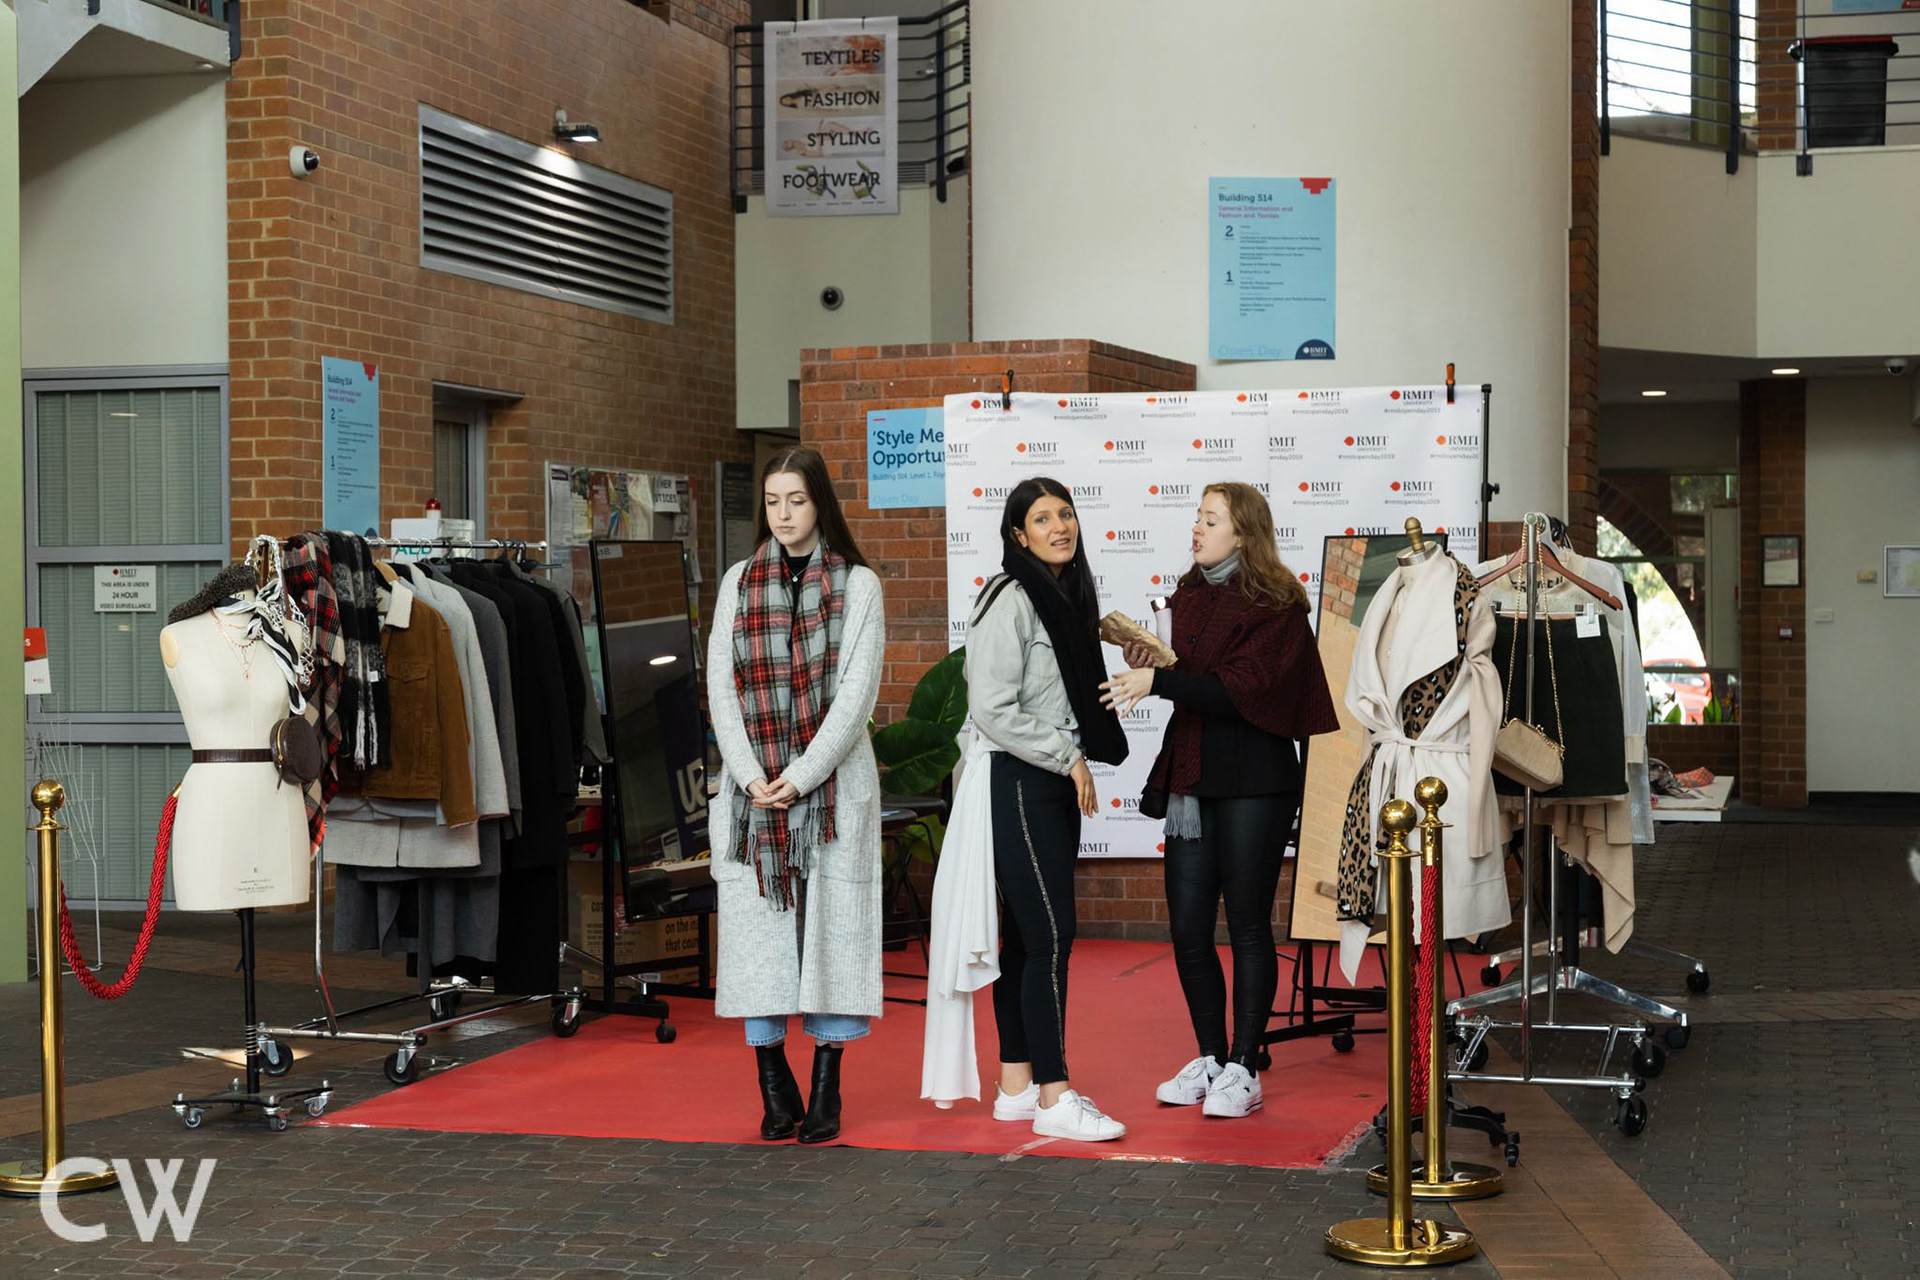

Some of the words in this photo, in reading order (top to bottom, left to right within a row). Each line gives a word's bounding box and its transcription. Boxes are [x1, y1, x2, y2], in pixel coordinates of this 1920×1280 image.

[802, 50, 881, 66] TEXTILES
[803, 91, 880, 107] FASHION
[807, 131, 881, 147] STYLING
[783, 172, 881, 189] FOOTWEAR
[1218, 193, 1256, 203] Building
[1225, 225, 1234, 237] 2
[1226, 270, 1233, 282] 1
[1249, 393, 1268, 402] RM
[1310, 391, 1343, 401] RMIT
[1403, 390, 1436, 400] RMIT
[1070, 397, 1101, 407] RMIT
[330, 408, 336, 420] 2
[873, 429, 915, 449] 'Style
[920, 428, 944, 443] Me
[1204, 438, 1236, 448] RMIT
[1357, 435, 1389, 446] RMIT
[1028, 442, 1059, 452] RMIT
[1116, 440, 1147, 450] RMIT
[330, 455, 335, 467] 1
[873, 450, 945, 469] Opportu
[1073, 486, 1104, 496] RMIT
[1161, 485, 1192, 495] RMIT
[1311, 482, 1343, 492] RMIT
[1403, 481, 1434, 491] RMIT
[1118, 530, 1149, 540] RMIT
[1358, 526, 1390, 536] RMIT
[119, 568, 137, 576] RMIT
[1123, 798, 1140, 808] RM
[1079, 842, 1111, 853] RMIT
[665, 938, 681, 952] that
